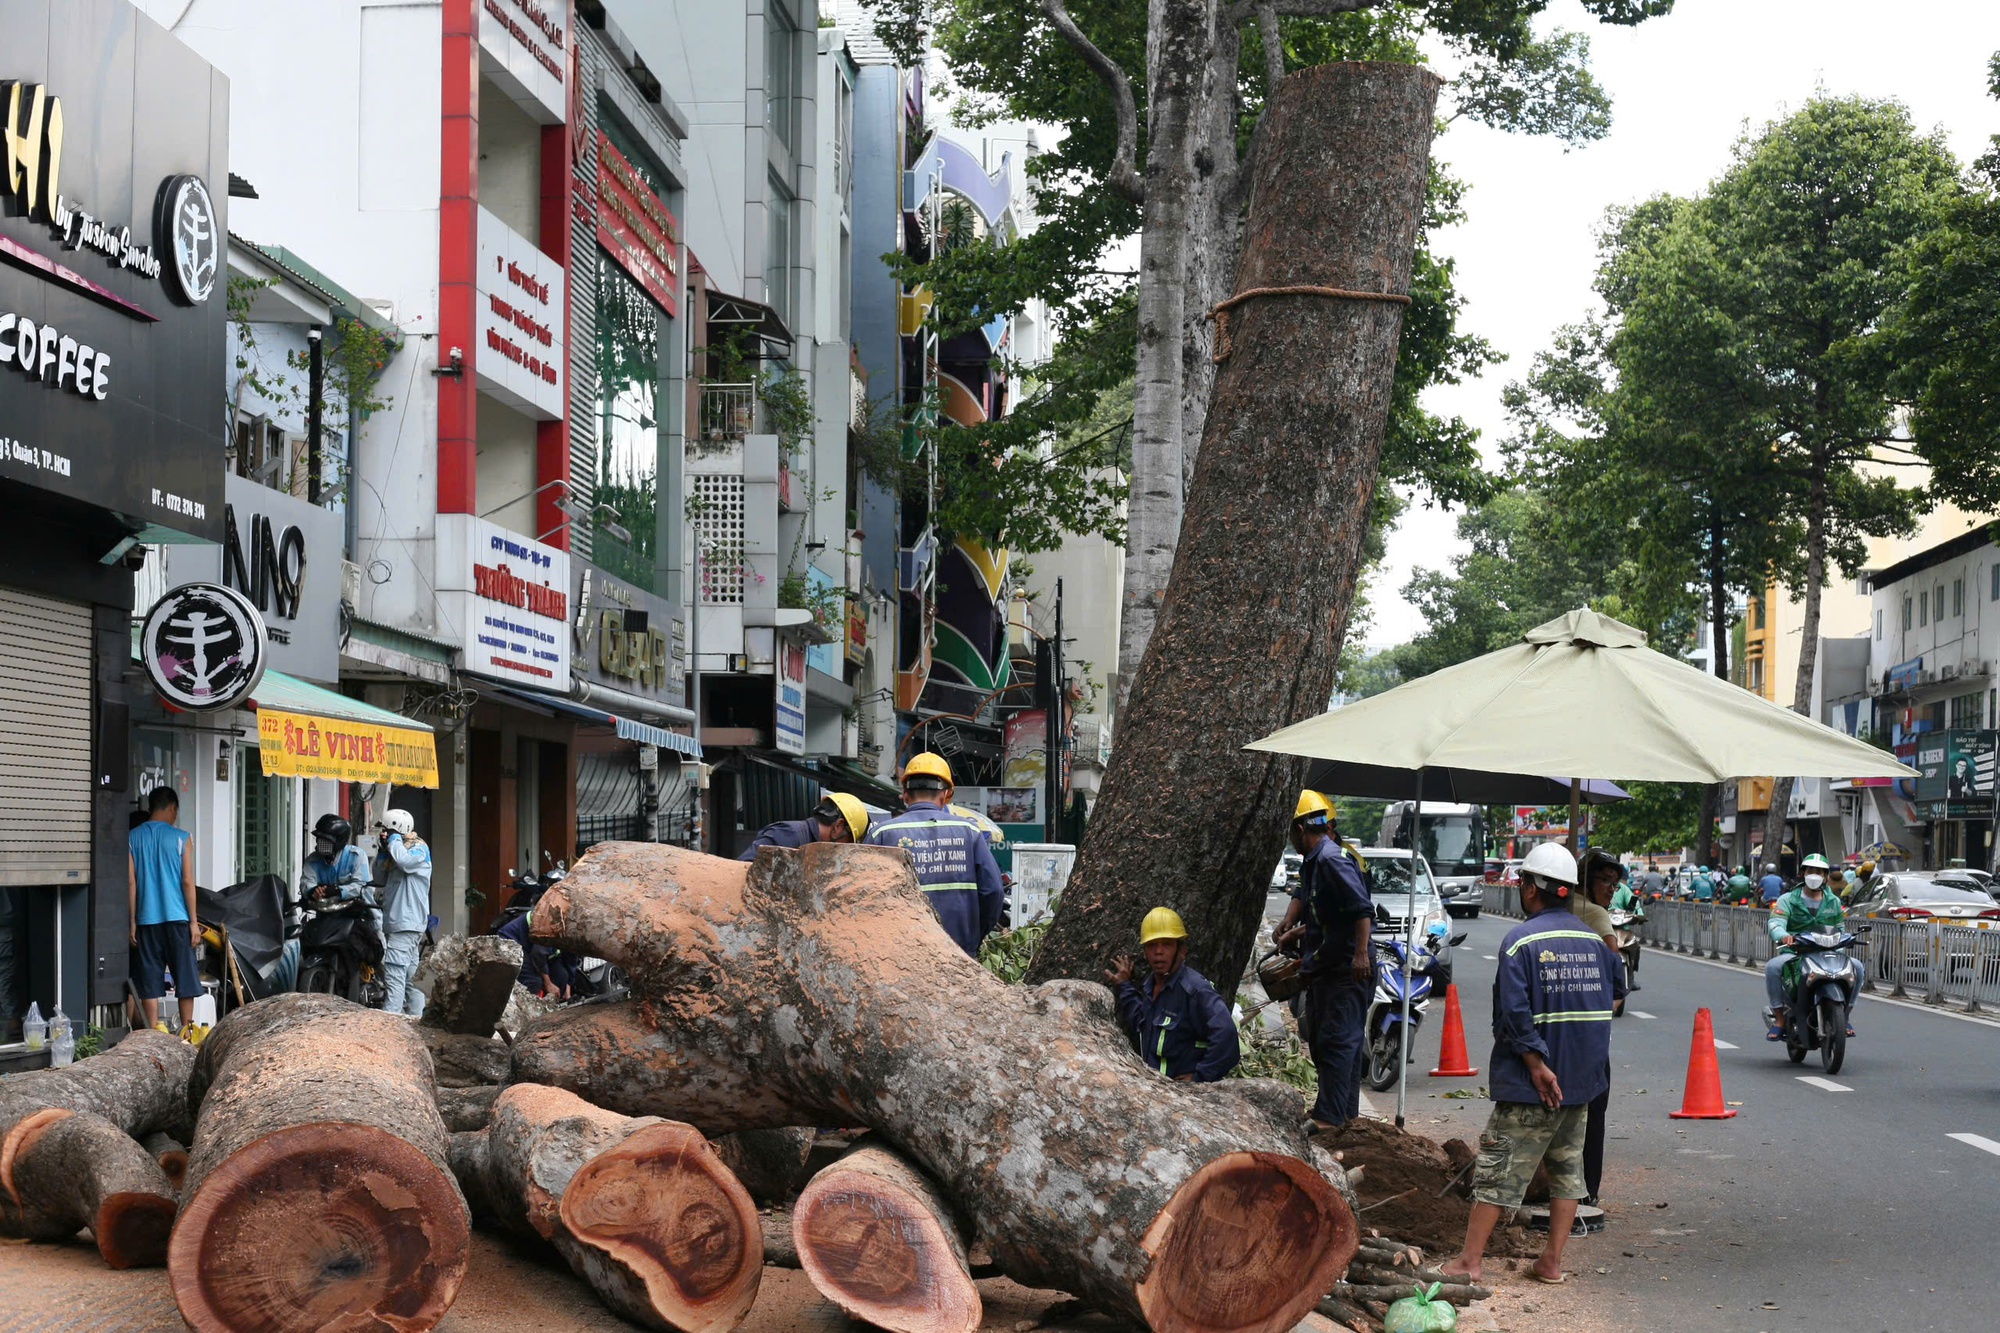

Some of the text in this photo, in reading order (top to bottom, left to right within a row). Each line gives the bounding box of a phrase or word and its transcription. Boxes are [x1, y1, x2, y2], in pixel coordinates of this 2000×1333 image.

[56, 194, 161, 280] by Fusion Smoke
[0, 313, 111, 400] COFFEE
[13, 440, 33, 466] Quận
[166, 493, 181, 513] 0772
[182, 498, 193, 516] 374
[194, 501, 205, 520] 374
[262, 717, 278, 733] 372
[295, 720, 320, 757] LÊ
[325, 731, 374, 763] VINH
[914, 837, 964, 849] CÔNG TY TNHH MTV
[917, 849, 966, 863] VIÊN CÂY XANH
[929, 863, 943, 873] CHÍ
[945, 864, 967, 872] MINH
[1540, 965, 1600, 981] CÔNG VIÊN CÂY XANH
[1568, 982, 1581, 992] CHÍ
[1583, 982, 1602, 992] MINH
